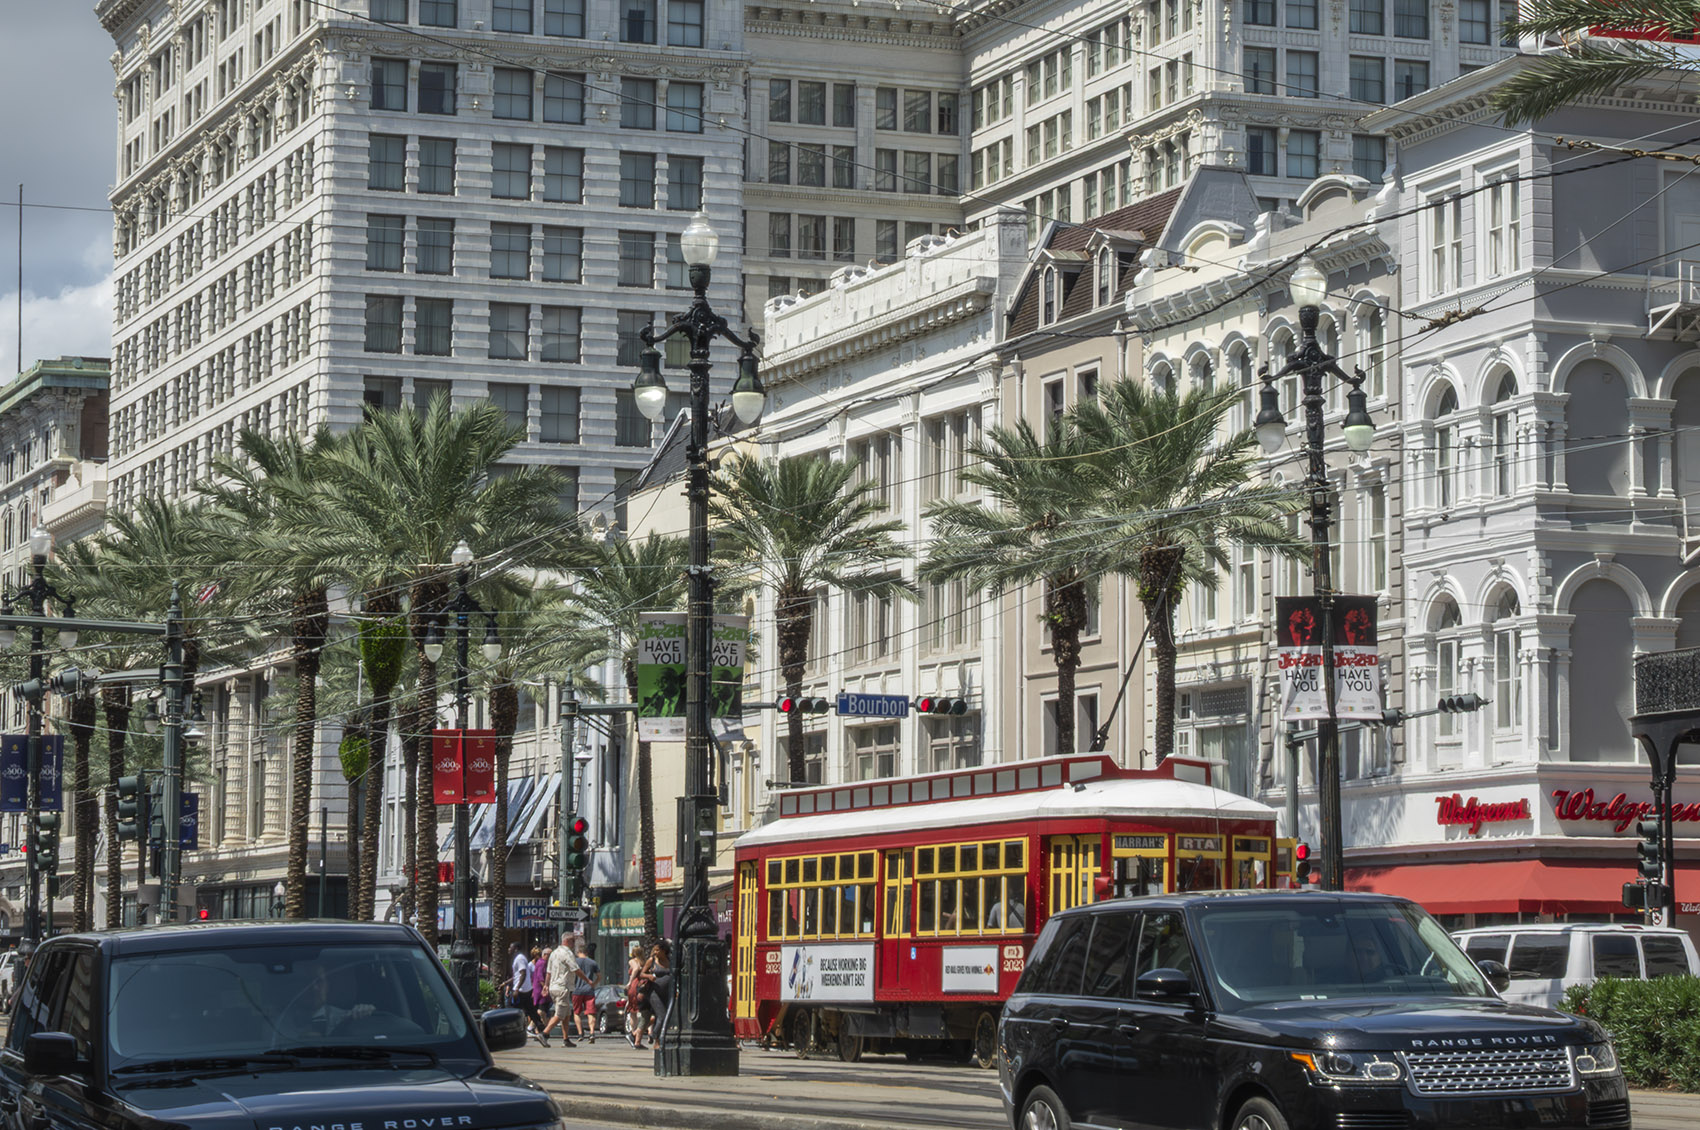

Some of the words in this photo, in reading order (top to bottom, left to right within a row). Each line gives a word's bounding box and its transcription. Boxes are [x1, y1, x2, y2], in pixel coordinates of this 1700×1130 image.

[644, 640, 680, 653] HAVE
[713, 643, 738, 655] AVE
[652, 653, 682, 665] YOU
[1285, 669, 1317, 681] HAVE
[1338, 669, 1371, 680] HAVE
[1293, 680, 1319, 692] YOU
[1346, 680, 1373, 692] YOU
[848, 695, 906, 715] Bourbon
[1435, 793, 1530, 834] Walgreens
[1115, 836, 1164, 849] HARRAH'S
[1183, 838, 1216, 849] RTA
[521, 907, 545, 917] IHOP
[550, 911, 562, 919] ONE
[565, 911, 577, 919] WAY
[820, 957, 838, 971] BECAUSE
[838, 957, 859, 971] WORKING
[859, 957, 867, 971] BIG
[1003, 960, 1024, 972] 2023
[821, 973, 842, 987] WEEKENDS
[842, 973, 854, 987] AIN'T
[1411, 1038, 1482, 1047] RANGE
[1491, 1035, 1556, 1044] ROVER
[384, 1115, 473, 1130] ROVER
